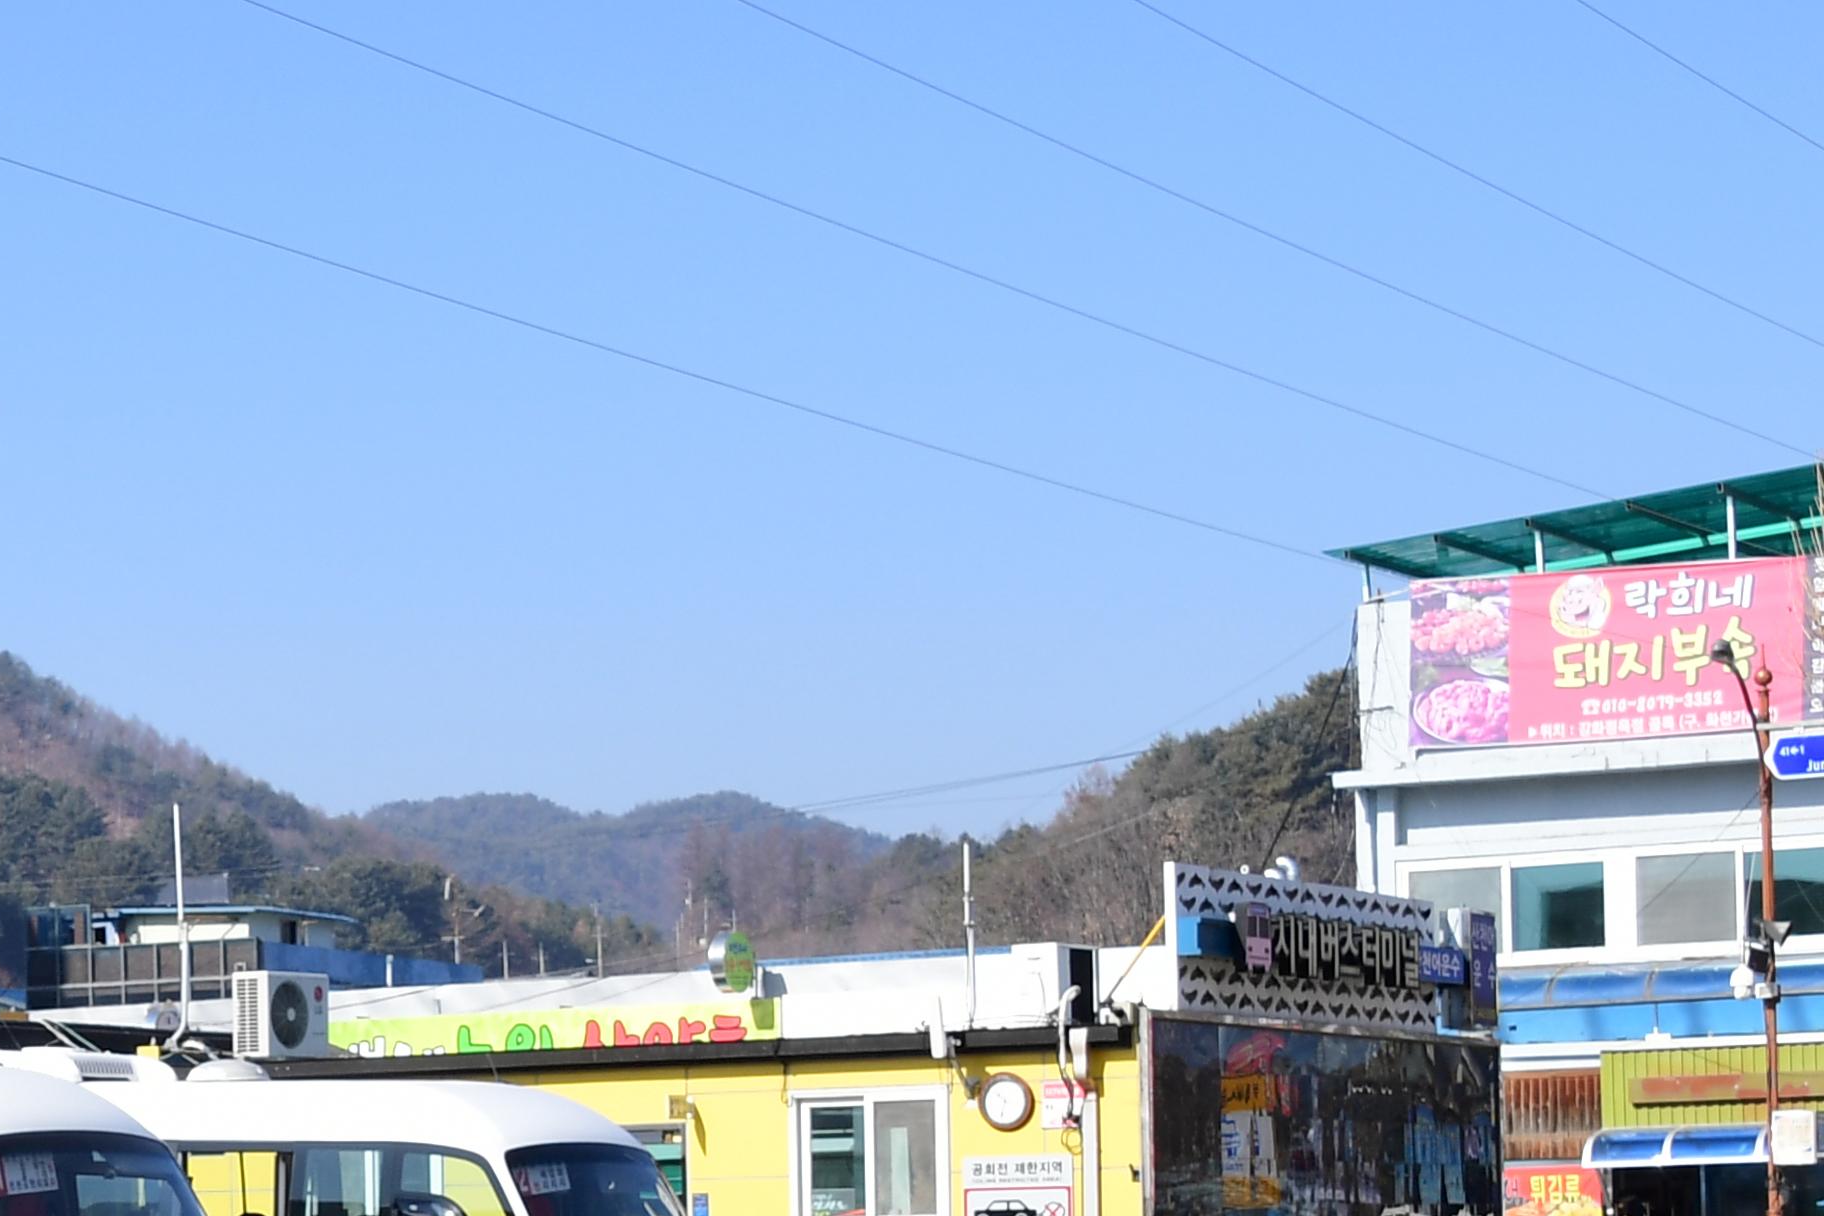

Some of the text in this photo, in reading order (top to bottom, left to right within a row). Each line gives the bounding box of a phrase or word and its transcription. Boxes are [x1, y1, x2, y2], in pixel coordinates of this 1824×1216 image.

[1625, 571, 1754, 619] 락희네
[1276, 914, 1420, 988] 시내버스터미널
[1419, 951, 1461, 978] 천어운수
[972, 1161, 1063, 1176] 공회전 제한지역
[1529, 1173, 1580, 1205] 튀김류
